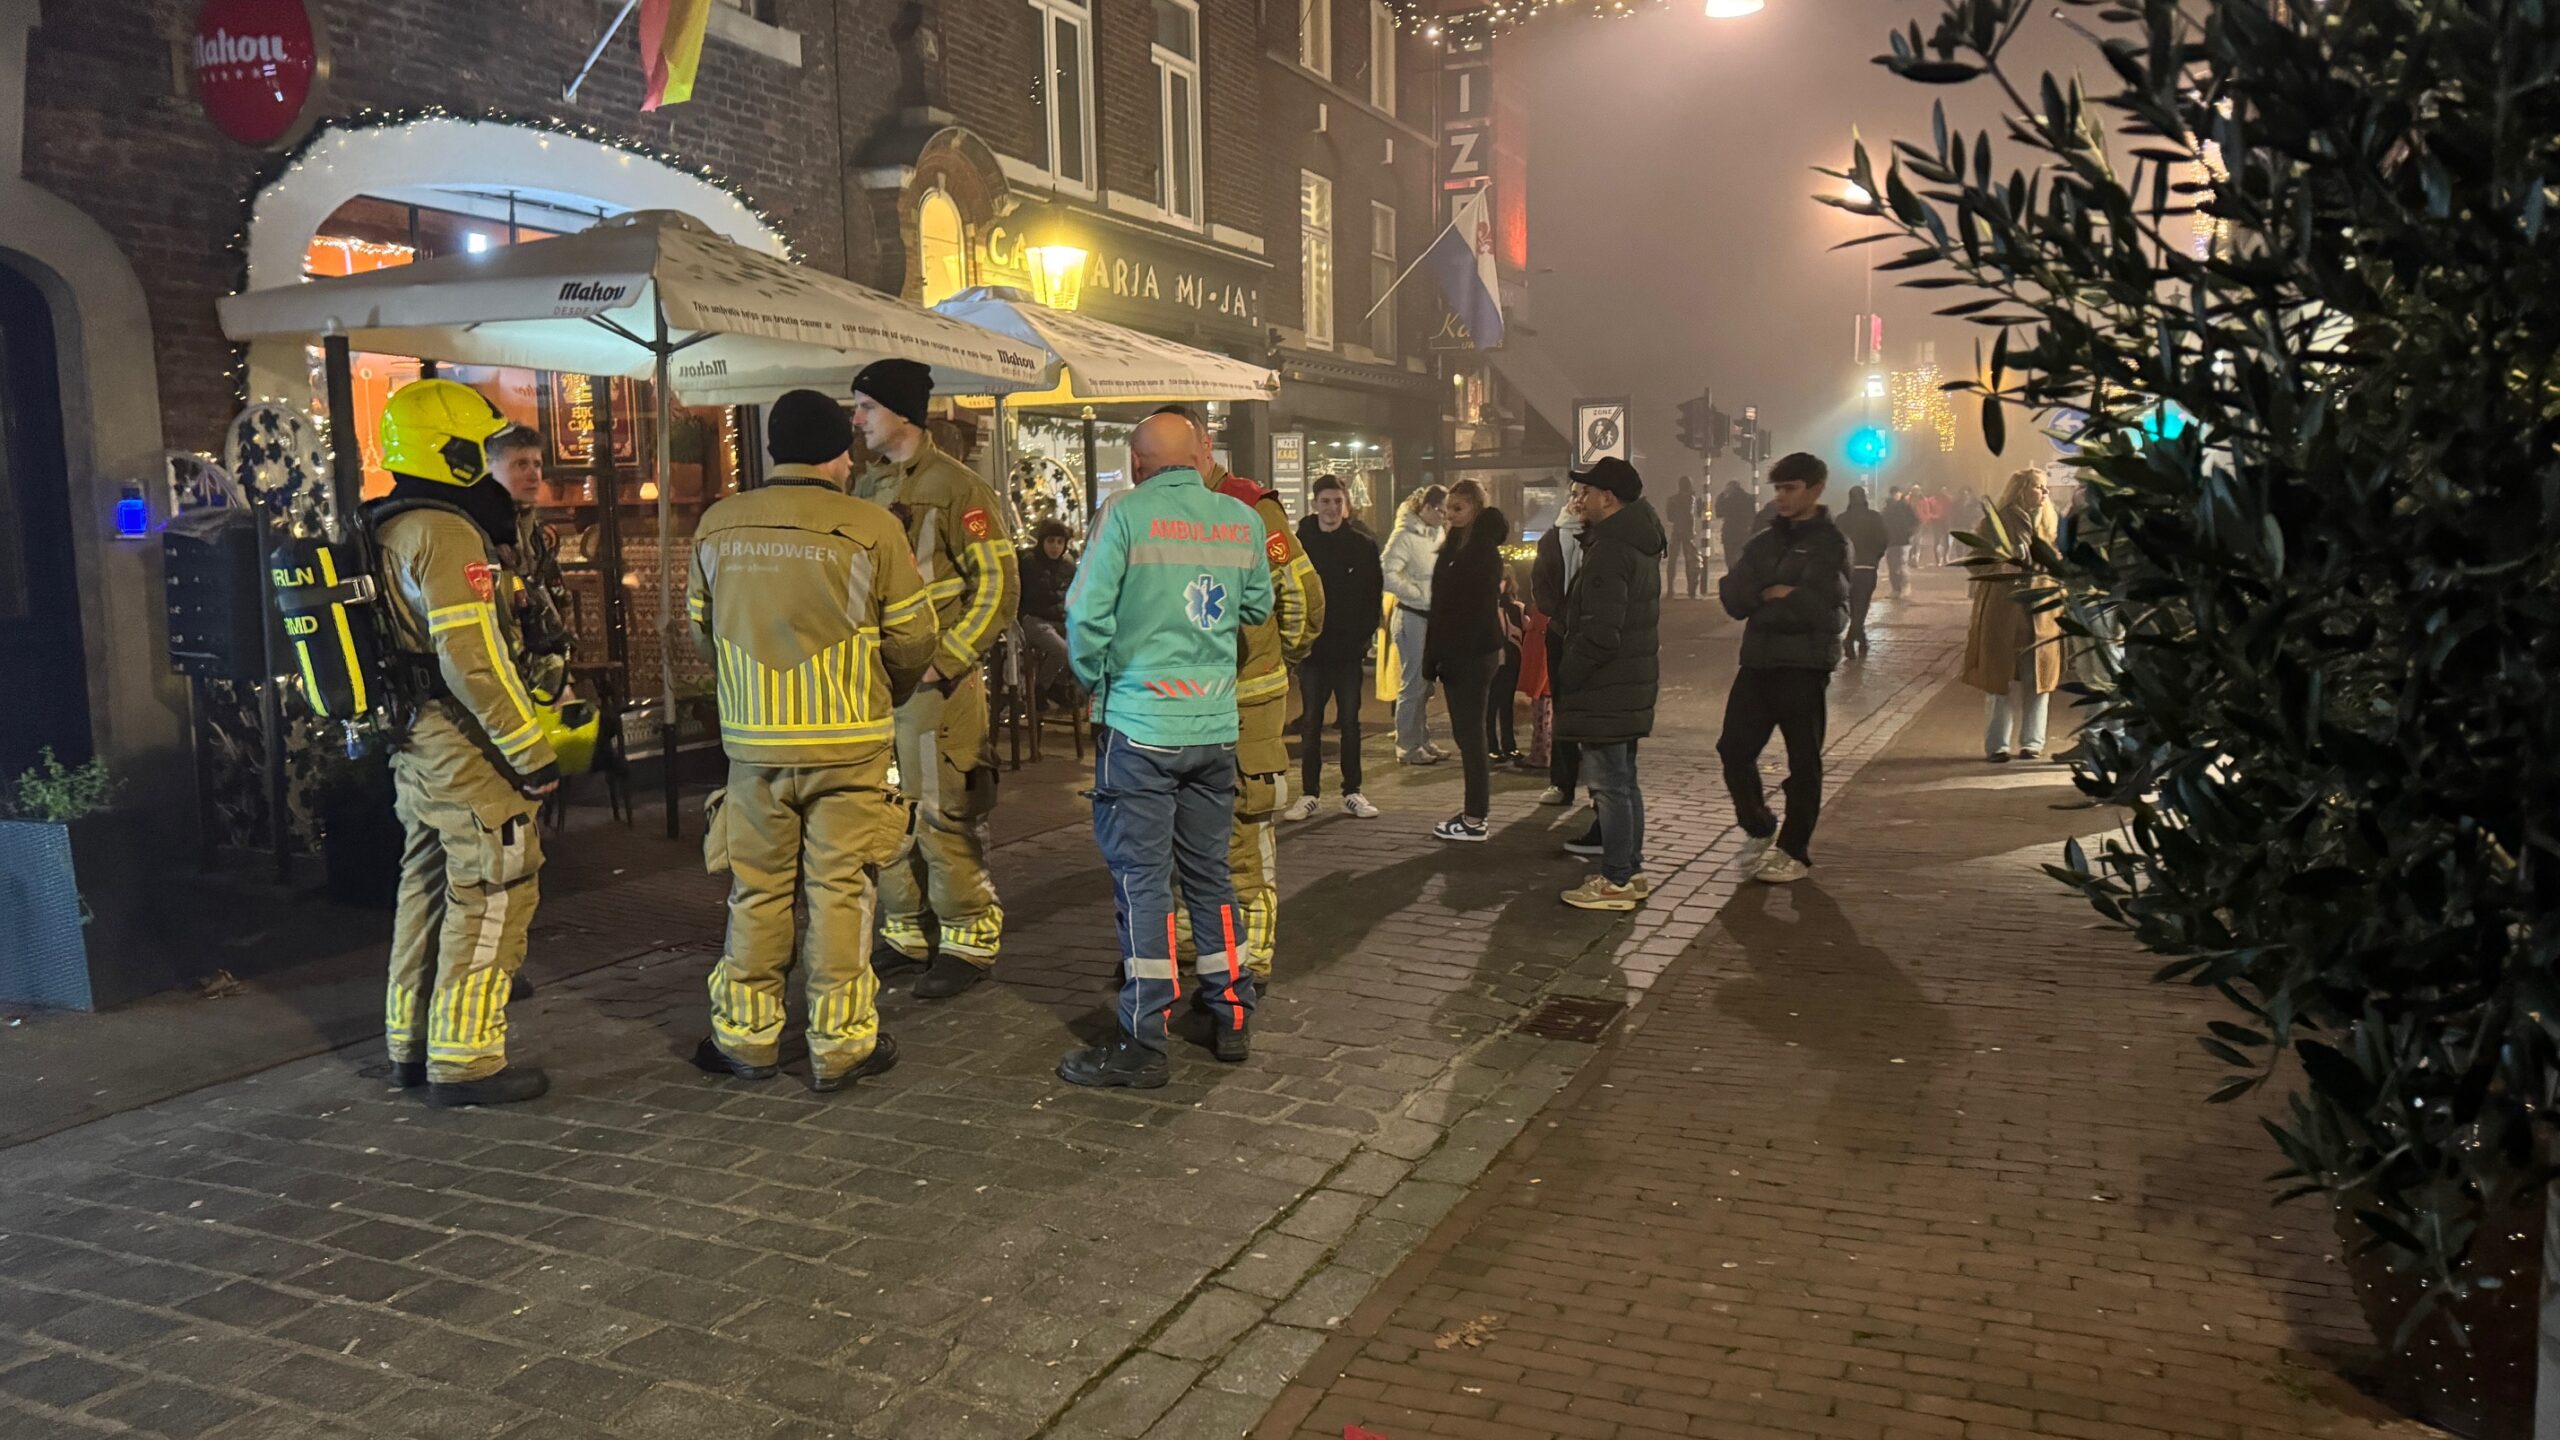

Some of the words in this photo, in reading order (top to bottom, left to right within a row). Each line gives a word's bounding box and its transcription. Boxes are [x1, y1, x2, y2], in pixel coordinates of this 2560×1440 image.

[1081, 252, 1159, 299] ARIA
[558, 281, 627, 302] Mahou
[997, 349, 1036, 371] Mahou
[1149, 518, 1252, 544] AMBULANCE
[719, 541, 839, 565] BRANDWEER
